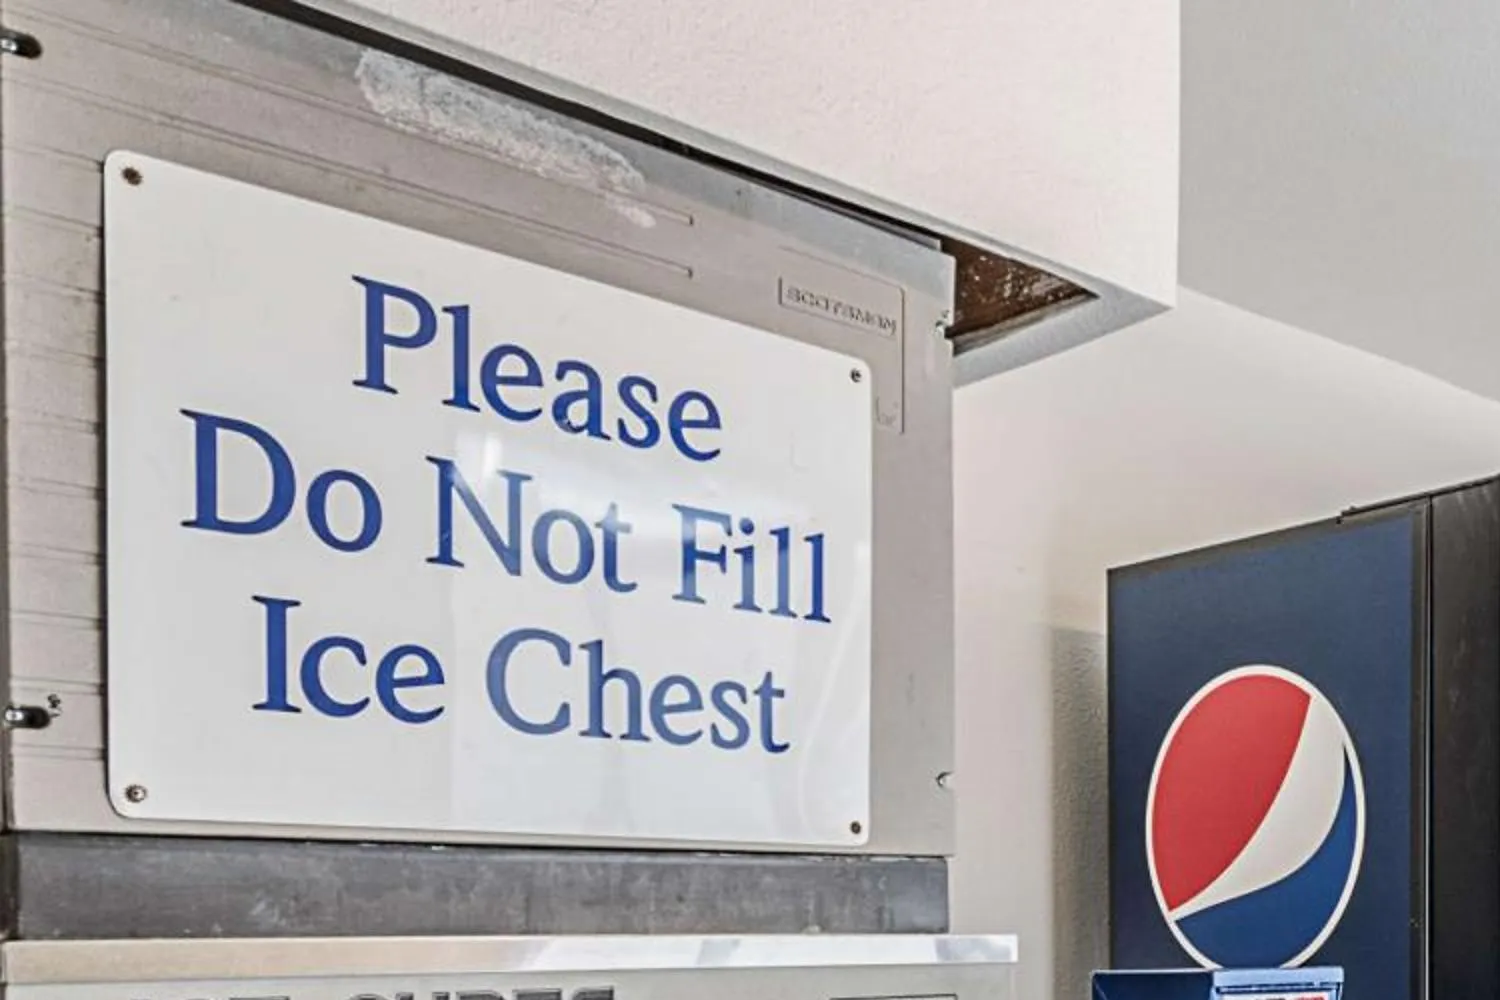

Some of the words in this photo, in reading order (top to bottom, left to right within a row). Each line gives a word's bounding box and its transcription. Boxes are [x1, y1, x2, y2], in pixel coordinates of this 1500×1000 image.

[352, 275, 723, 461] Please
[180, 408, 382, 552] Do
[426, 456, 638, 593] Not
[672, 503, 832, 623] Fill
[251, 595, 446, 724] Ice
[485, 628, 791, 754] Chest
